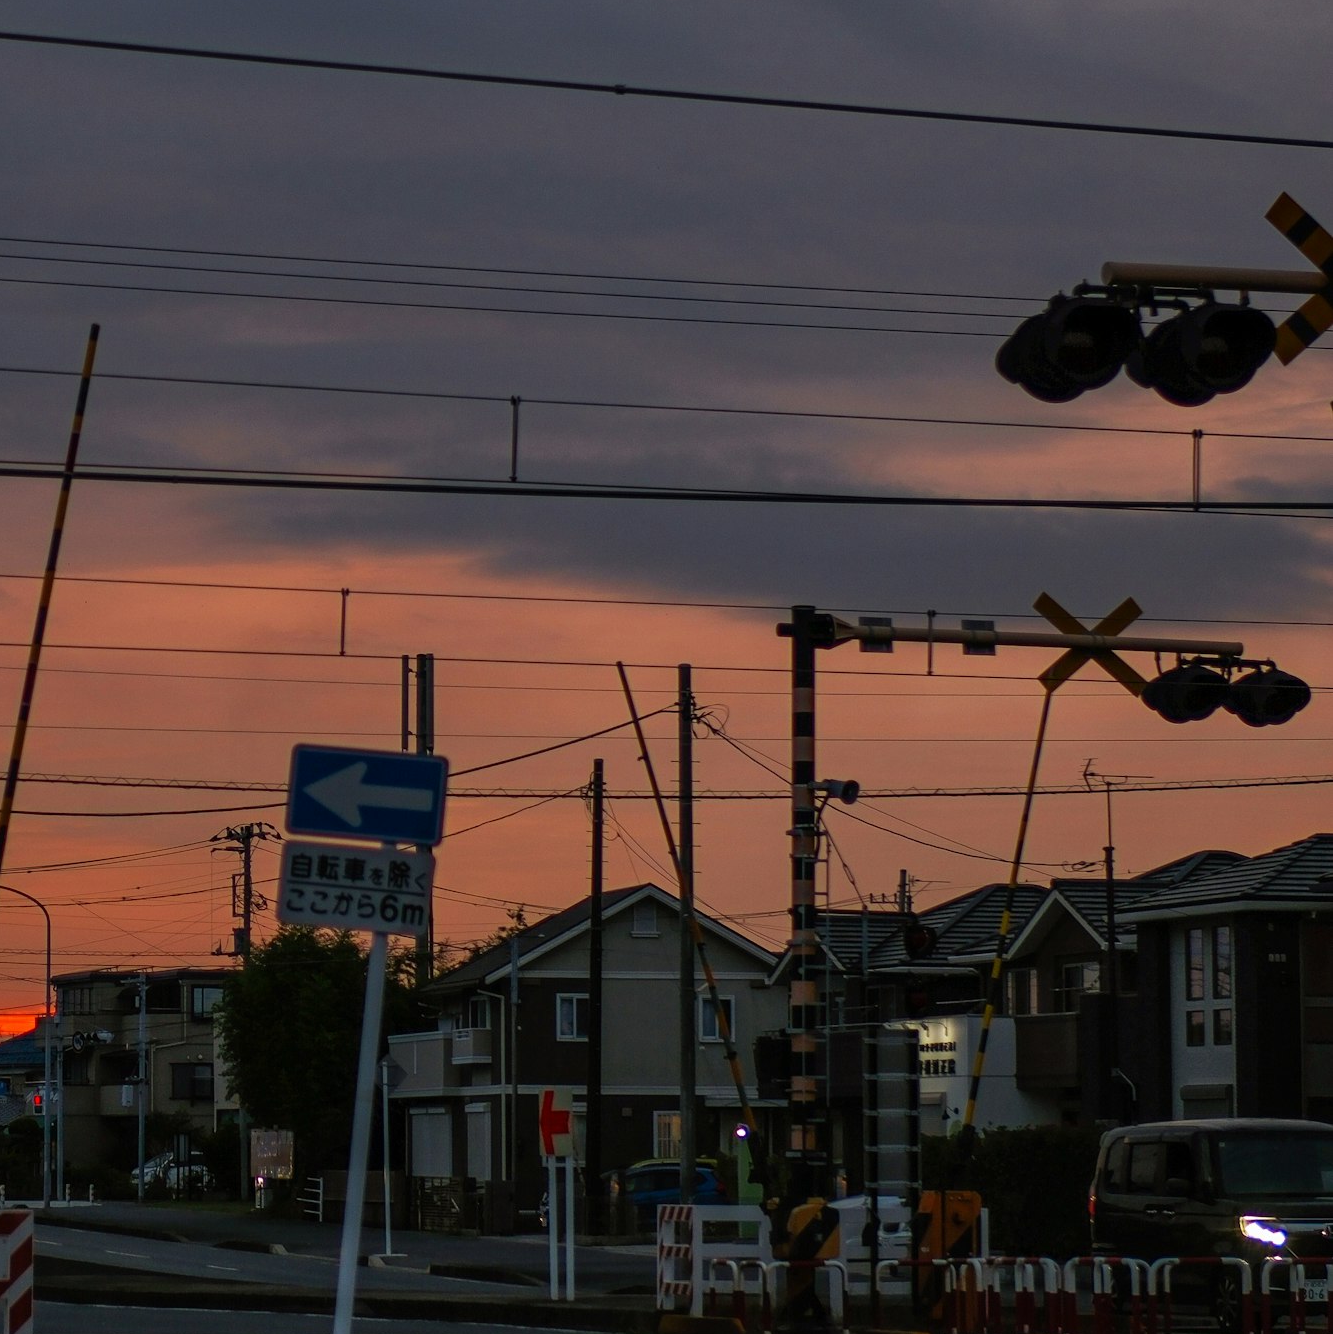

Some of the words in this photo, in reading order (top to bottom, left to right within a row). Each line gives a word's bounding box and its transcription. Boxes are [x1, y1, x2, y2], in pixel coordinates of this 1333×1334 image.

[291, 853, 426, 891] 自転車を除く
[286, 887, 424, 926] ここから6m
